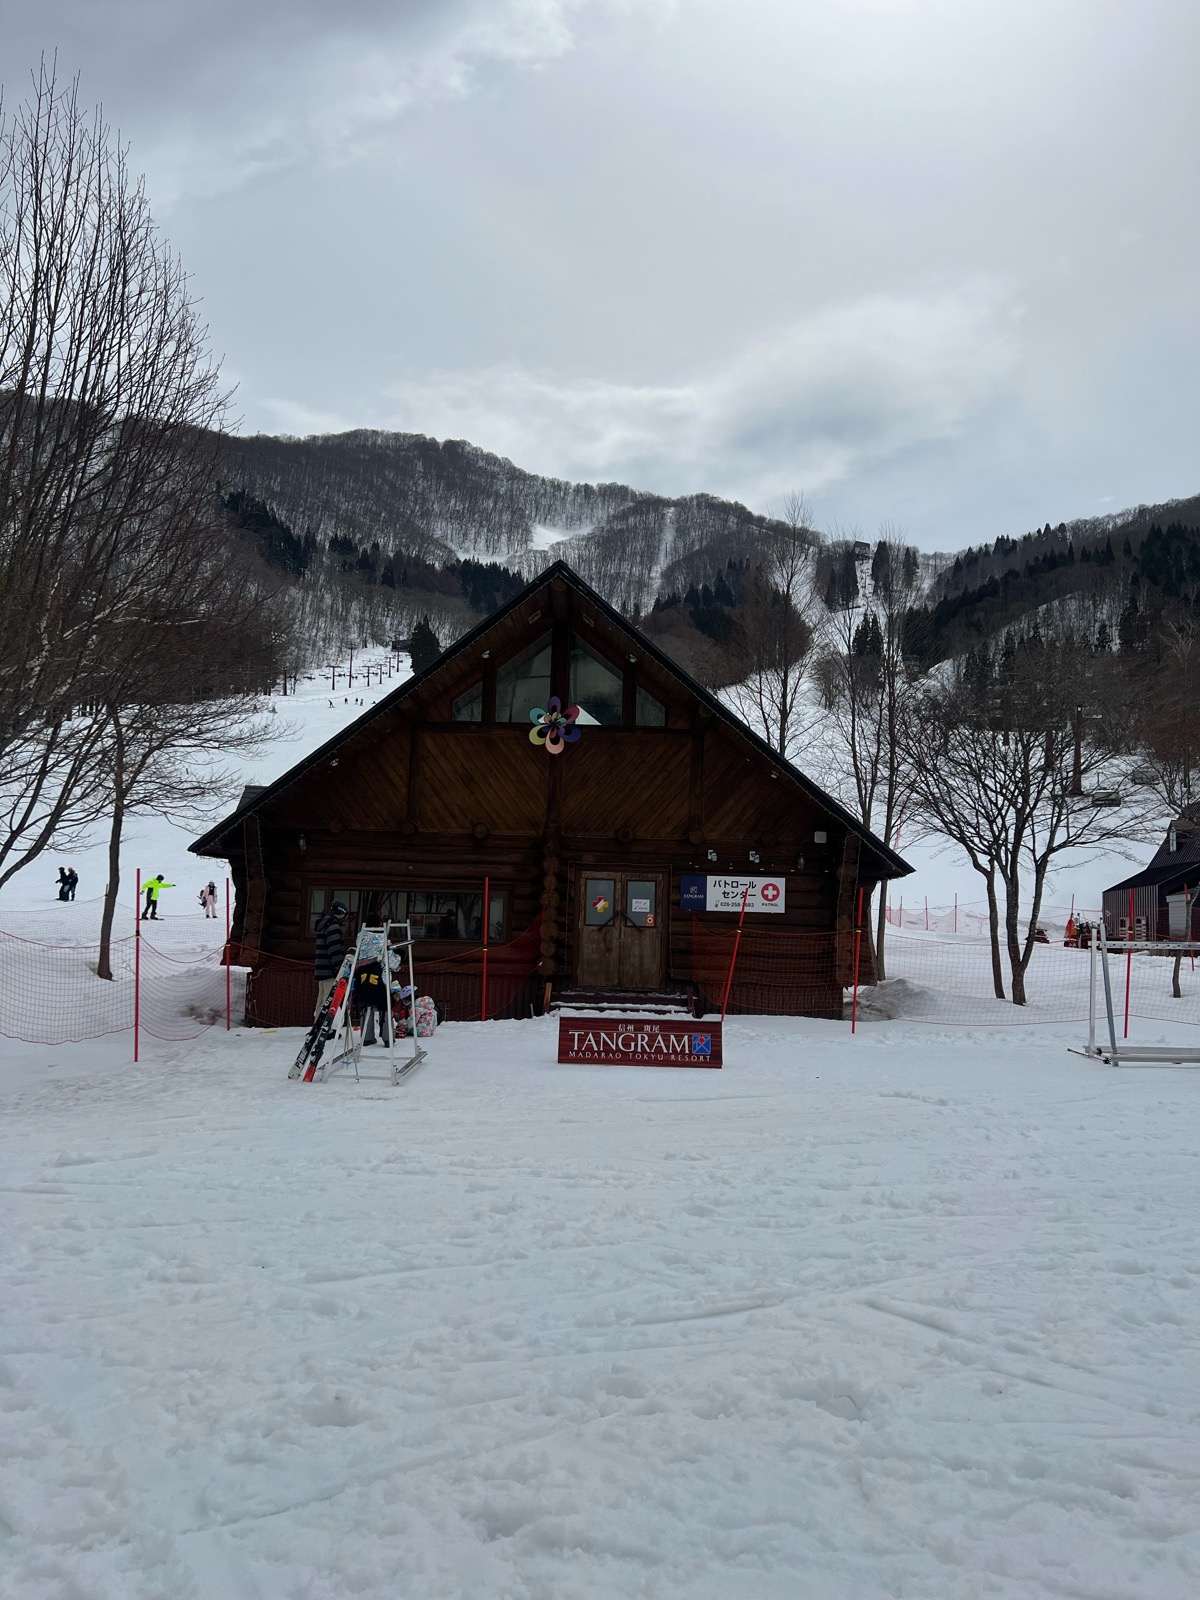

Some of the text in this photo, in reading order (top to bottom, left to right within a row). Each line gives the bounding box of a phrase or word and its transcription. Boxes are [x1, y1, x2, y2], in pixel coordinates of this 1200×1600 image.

[618, 1023, 634, 1032] 信州
[568, 1031, 690, 1054] TANGRAM
[569, 1051, 622, 1060] MADARAO
[671, 1054, 711, 1063] RESORT
